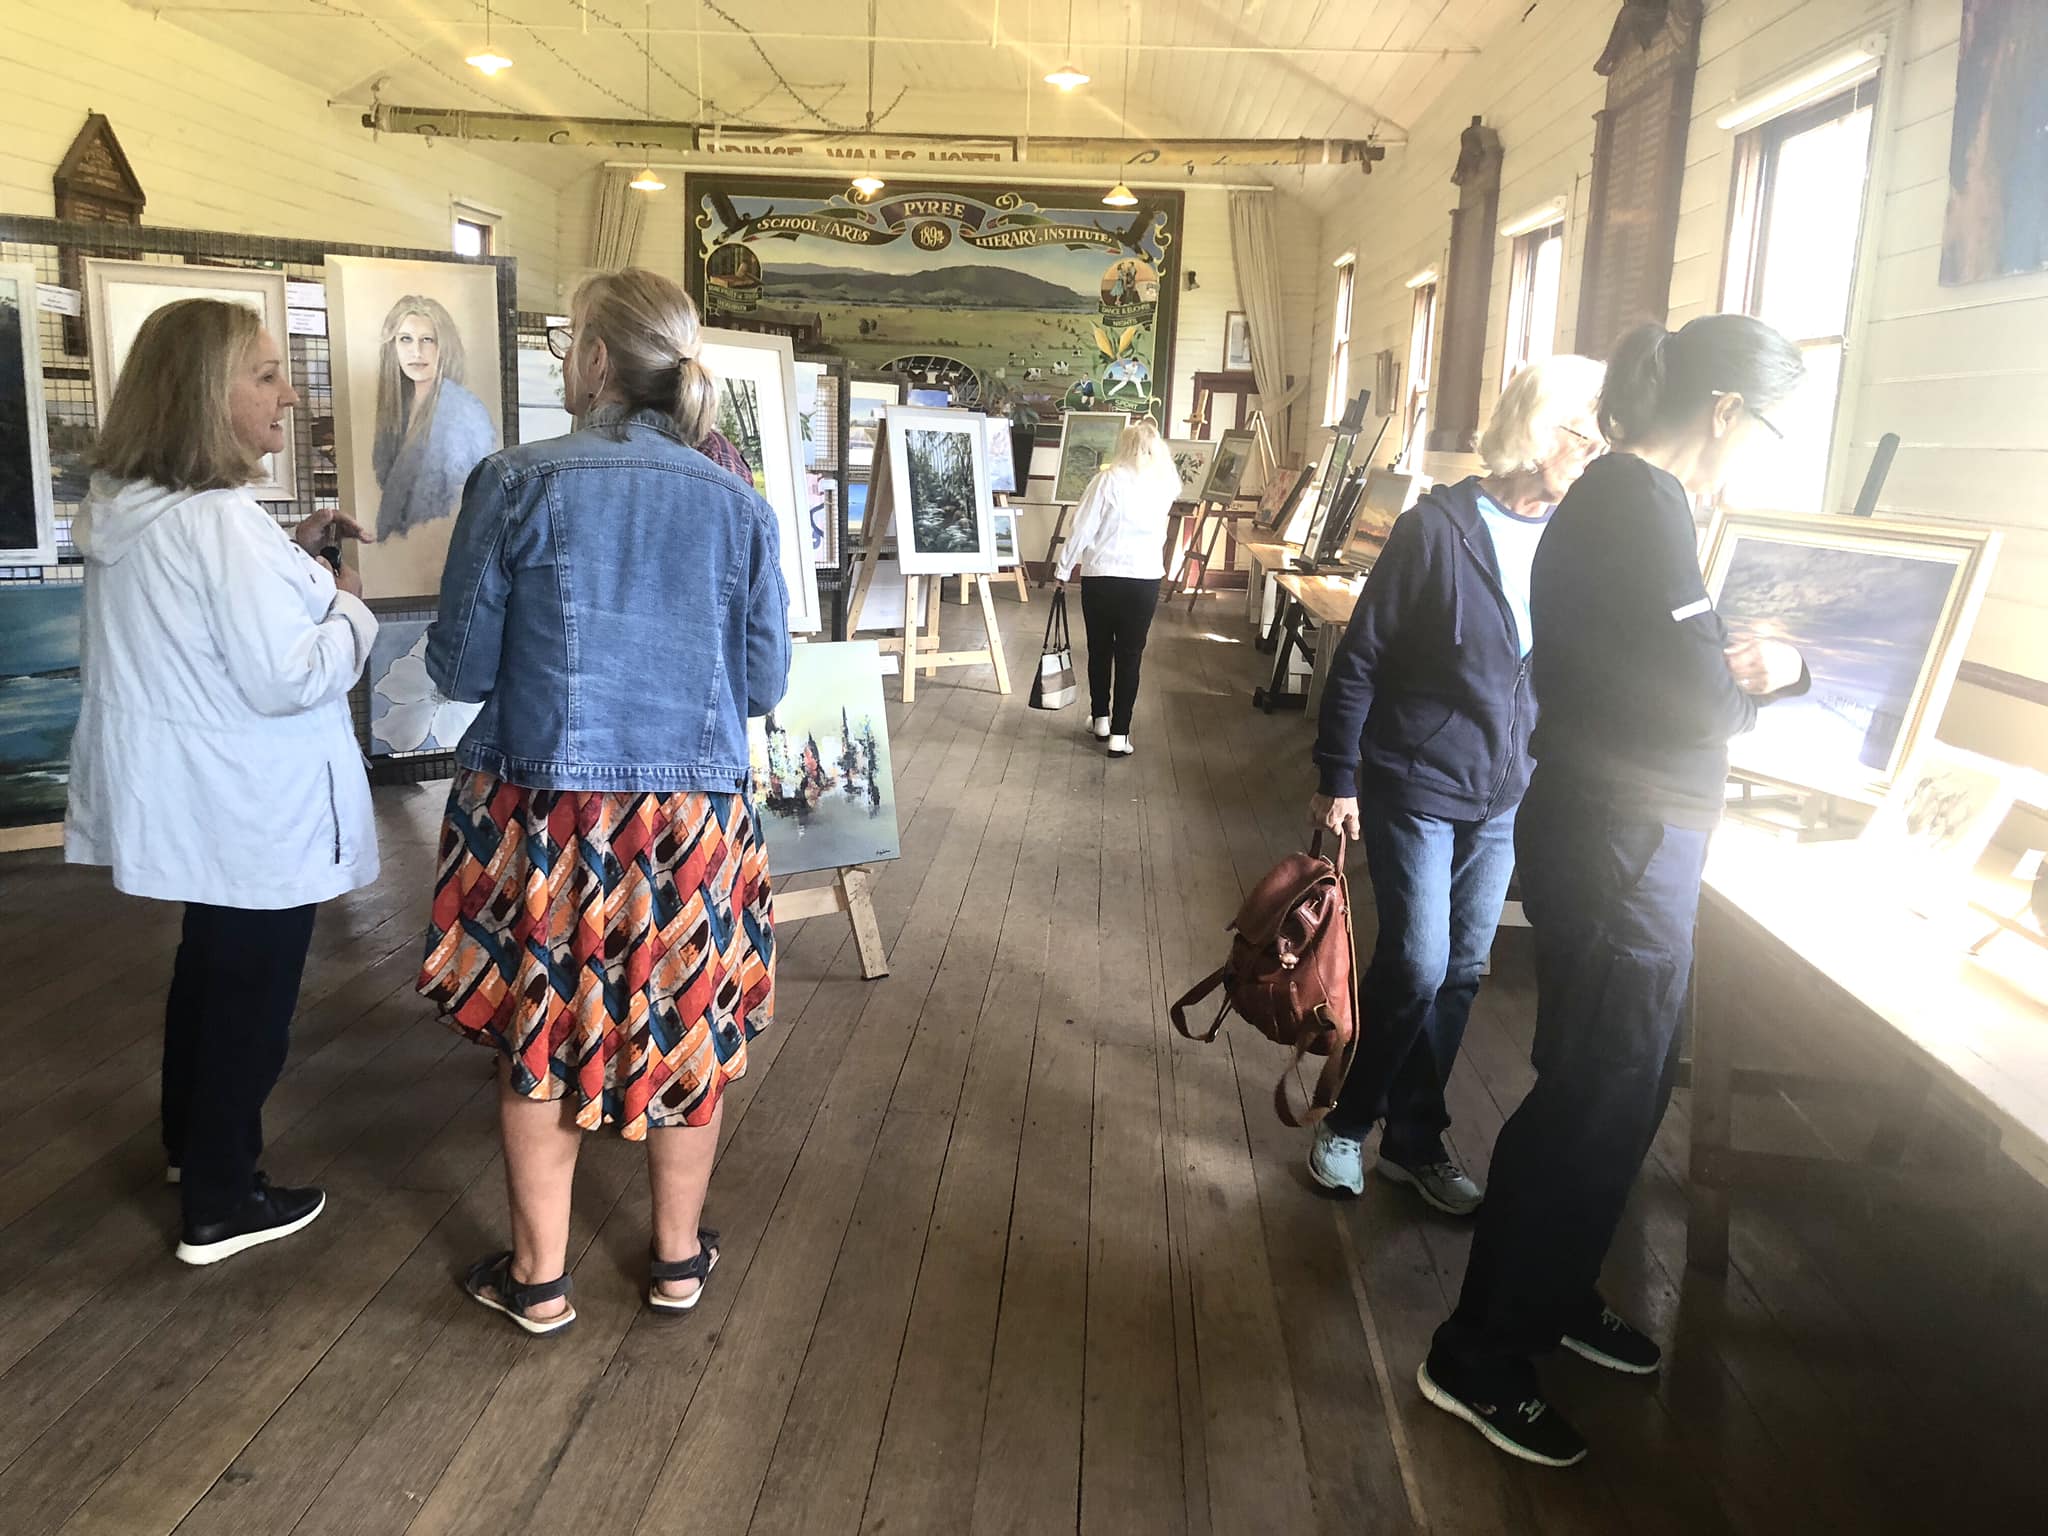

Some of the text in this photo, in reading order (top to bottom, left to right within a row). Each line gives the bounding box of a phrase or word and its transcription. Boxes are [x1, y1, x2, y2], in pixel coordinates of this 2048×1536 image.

[904, 200, 966, 219] PYREE
[757, 218, 820, 233] SCHOOL
[830, 222, 871, 242] ARTS
[920, 226, 945, 247] 1894
[1101, 306, 1121, 315] DANCE
[1114, 399, 1138, 410] SPORT
